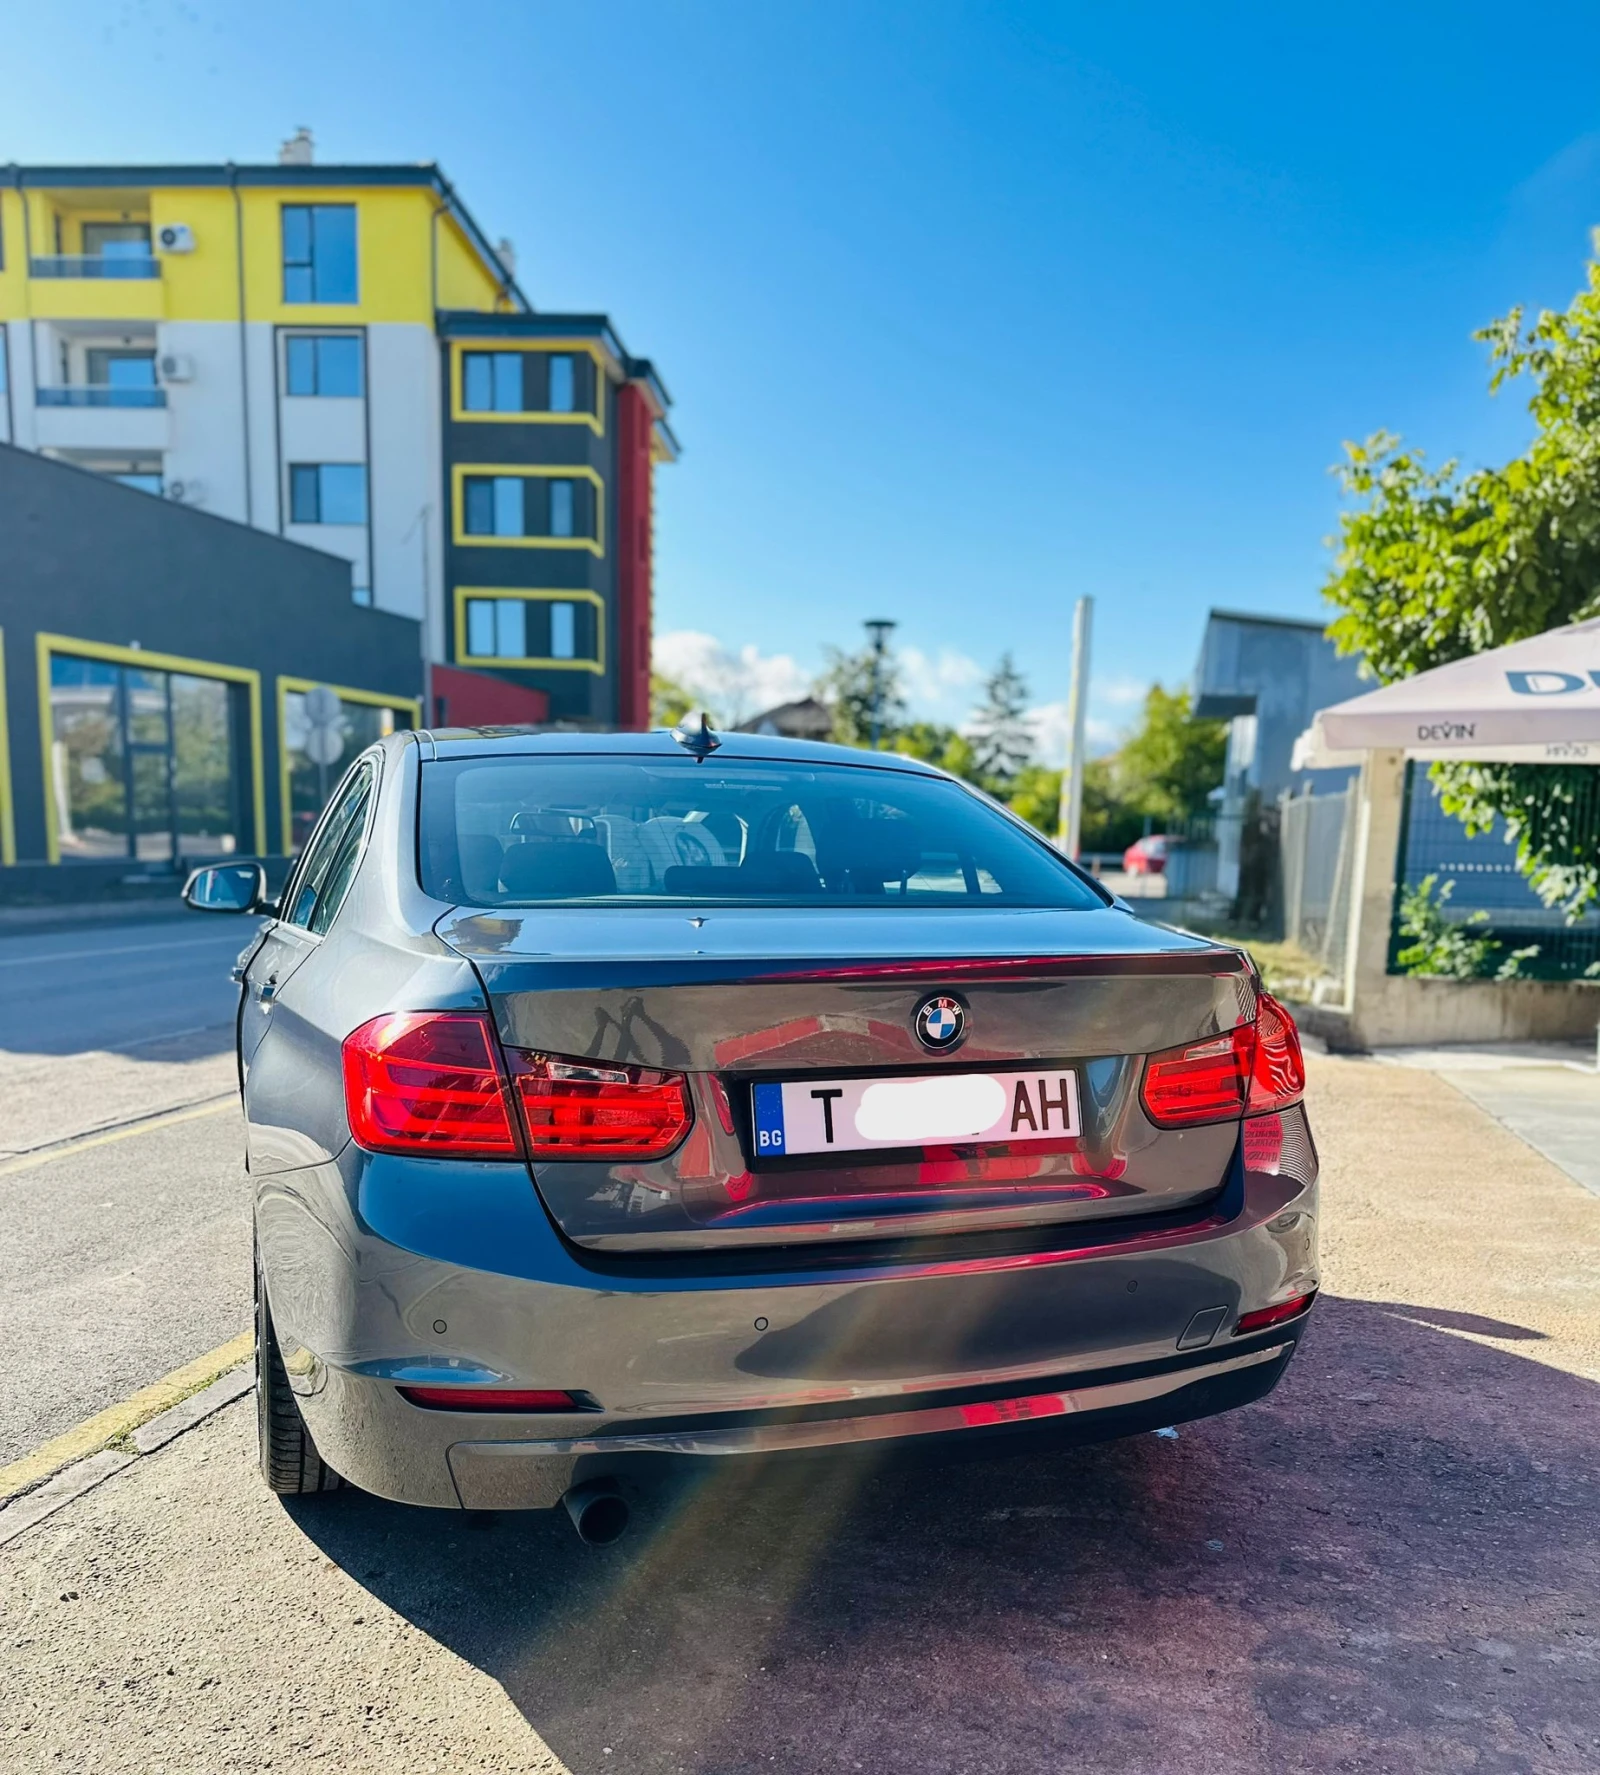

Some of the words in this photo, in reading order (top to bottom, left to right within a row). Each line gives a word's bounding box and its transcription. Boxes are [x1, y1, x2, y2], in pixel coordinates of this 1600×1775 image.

[1505, 670, 1600, 695] D
[1418, 721, 1475, 741] DEVIN
[923, 999, 961, 1016] BMW
[810, 1088, 843, 1144] T
[1010, 1078, 1070, 1133] AH
[759, 1129, 782, 1148] BG
